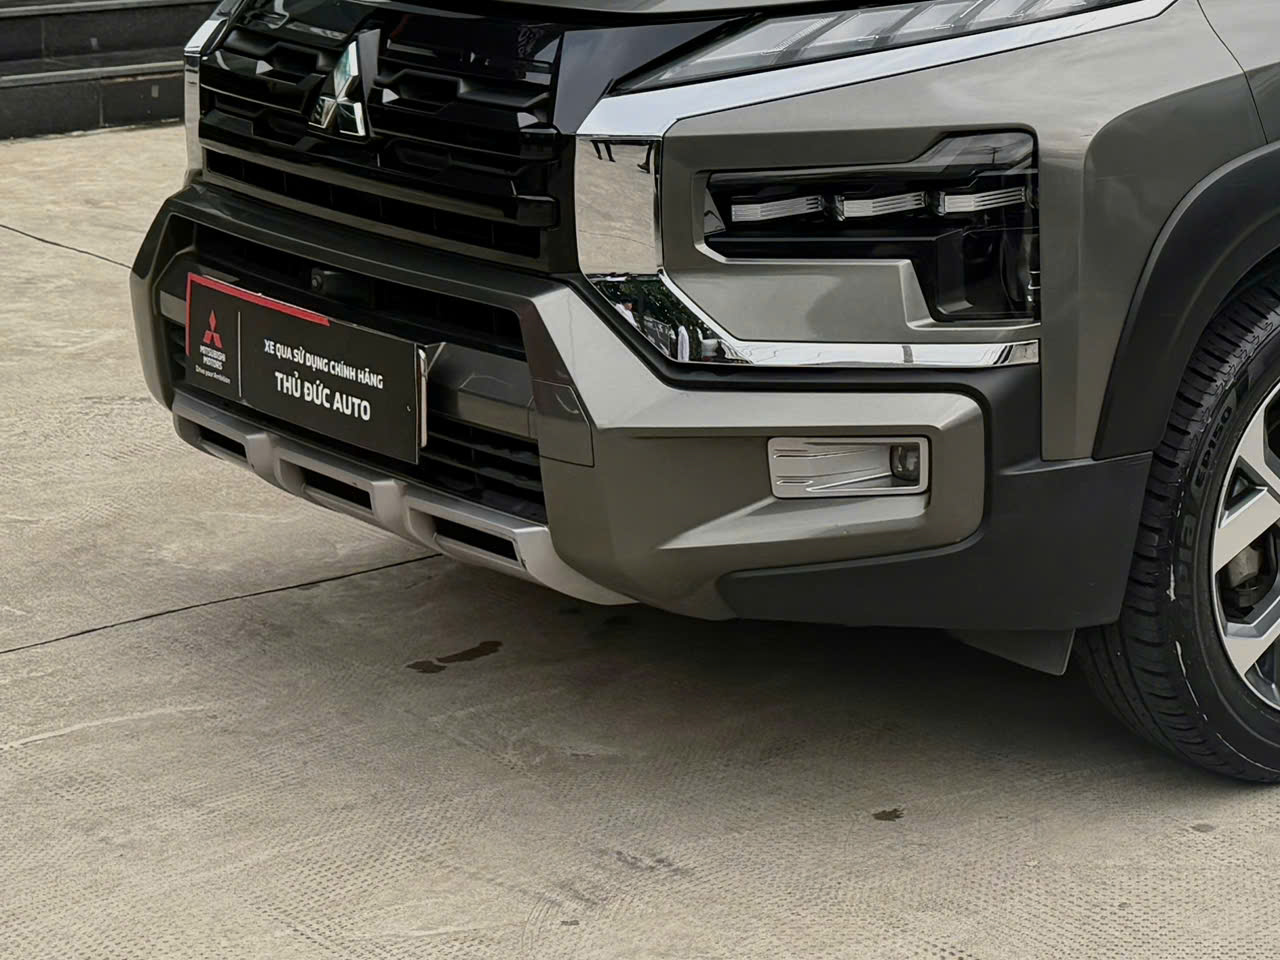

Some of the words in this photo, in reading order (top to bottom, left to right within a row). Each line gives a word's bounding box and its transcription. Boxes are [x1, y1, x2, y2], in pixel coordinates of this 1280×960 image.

[264, 339, 275, 354] XE
[275, 343, 292, 360] QUA
[293, 346, 305, 364] SỬ
[305, 352, 329, 372] DỤNG
[329, 360, 356, 381] CHÍNH
[357, 367, 384, 389] HÃNG
[275, 371, 301, 398] THỦ
[303, 380, 331, 408] ĐỨC
[332, 391, 371, 421] AUTO
